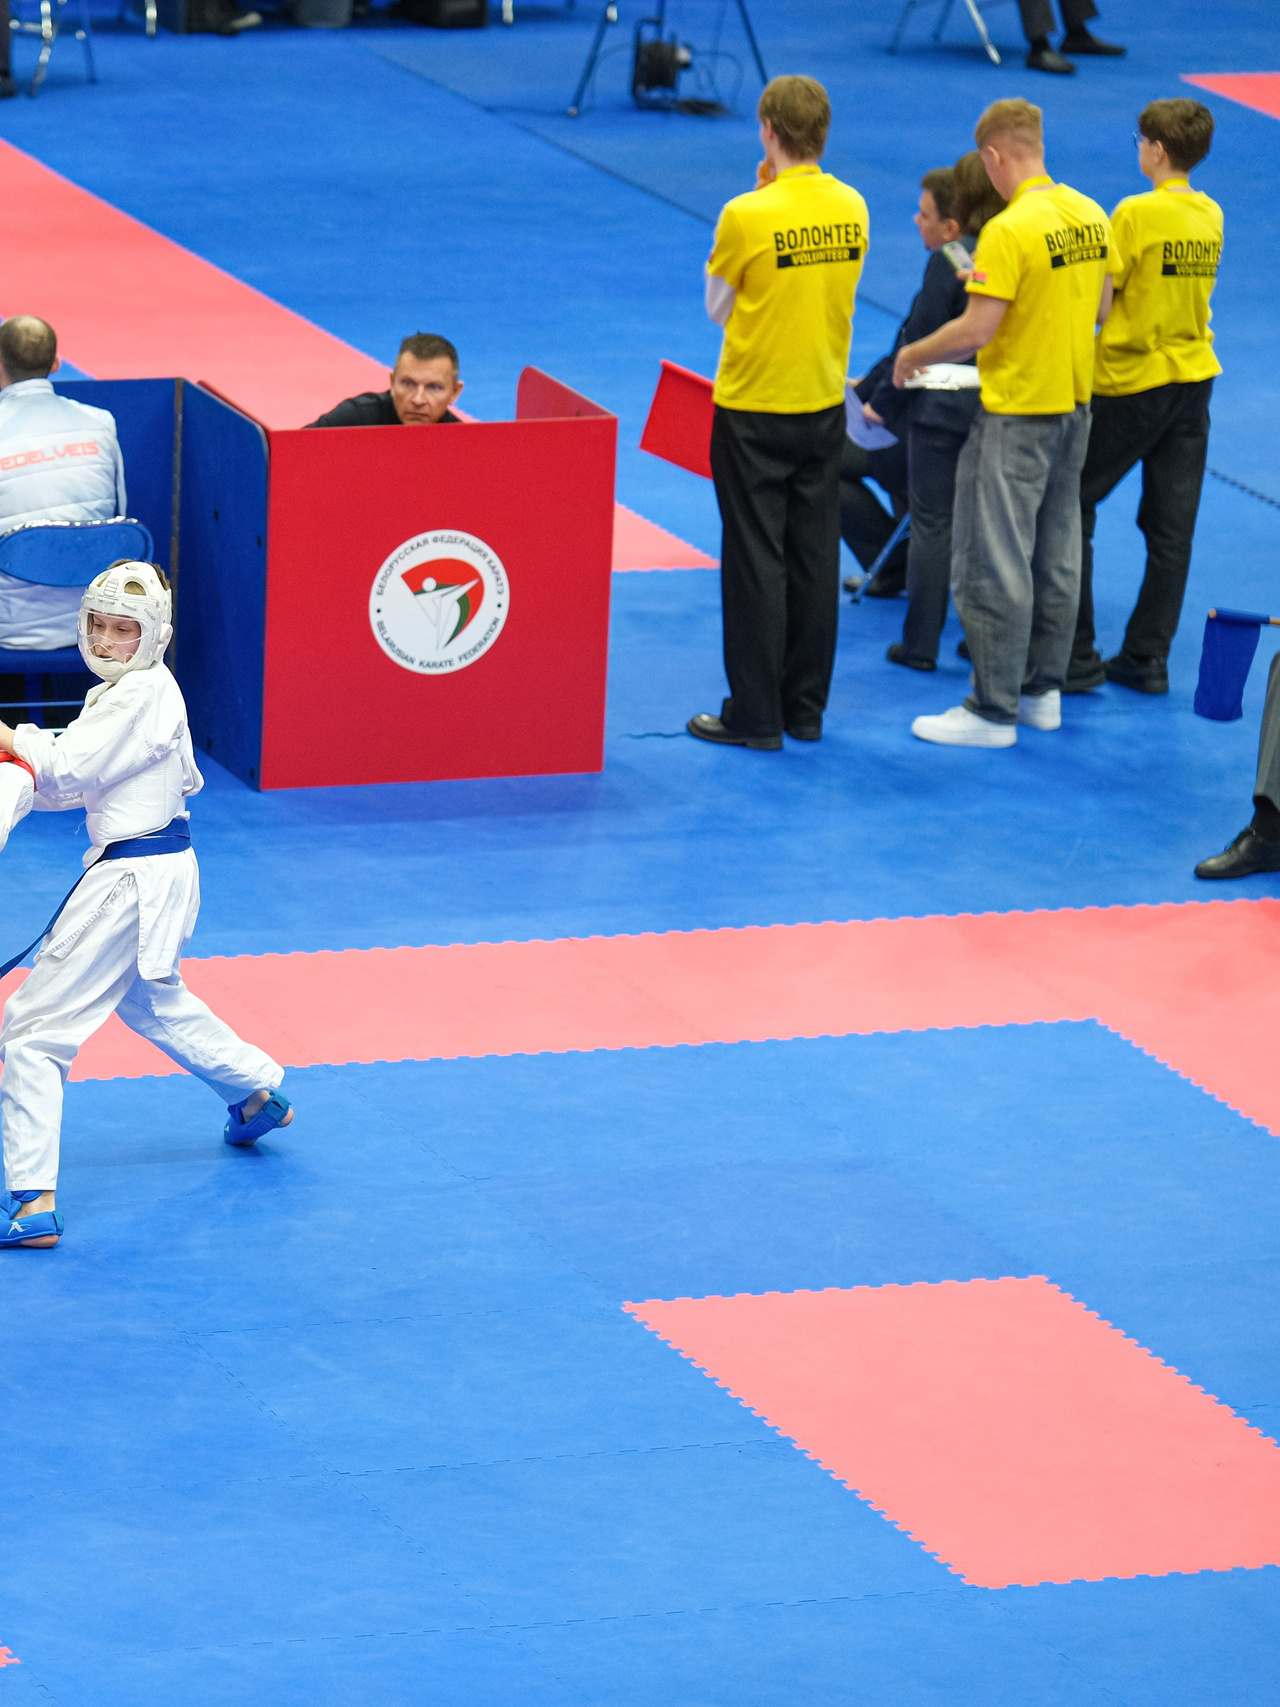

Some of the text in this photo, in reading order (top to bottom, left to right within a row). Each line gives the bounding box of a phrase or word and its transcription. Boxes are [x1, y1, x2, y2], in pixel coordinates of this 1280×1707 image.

[774, 223, 862, 251] ВОЛОНТЕР
[0, 441, 100, 471] EDELVEIS
[376, 538, 429, 596] БЕЛОРУССКАЯ
[376, 616, 500, 669] BELARUSIAN KARATE FEDERATION
